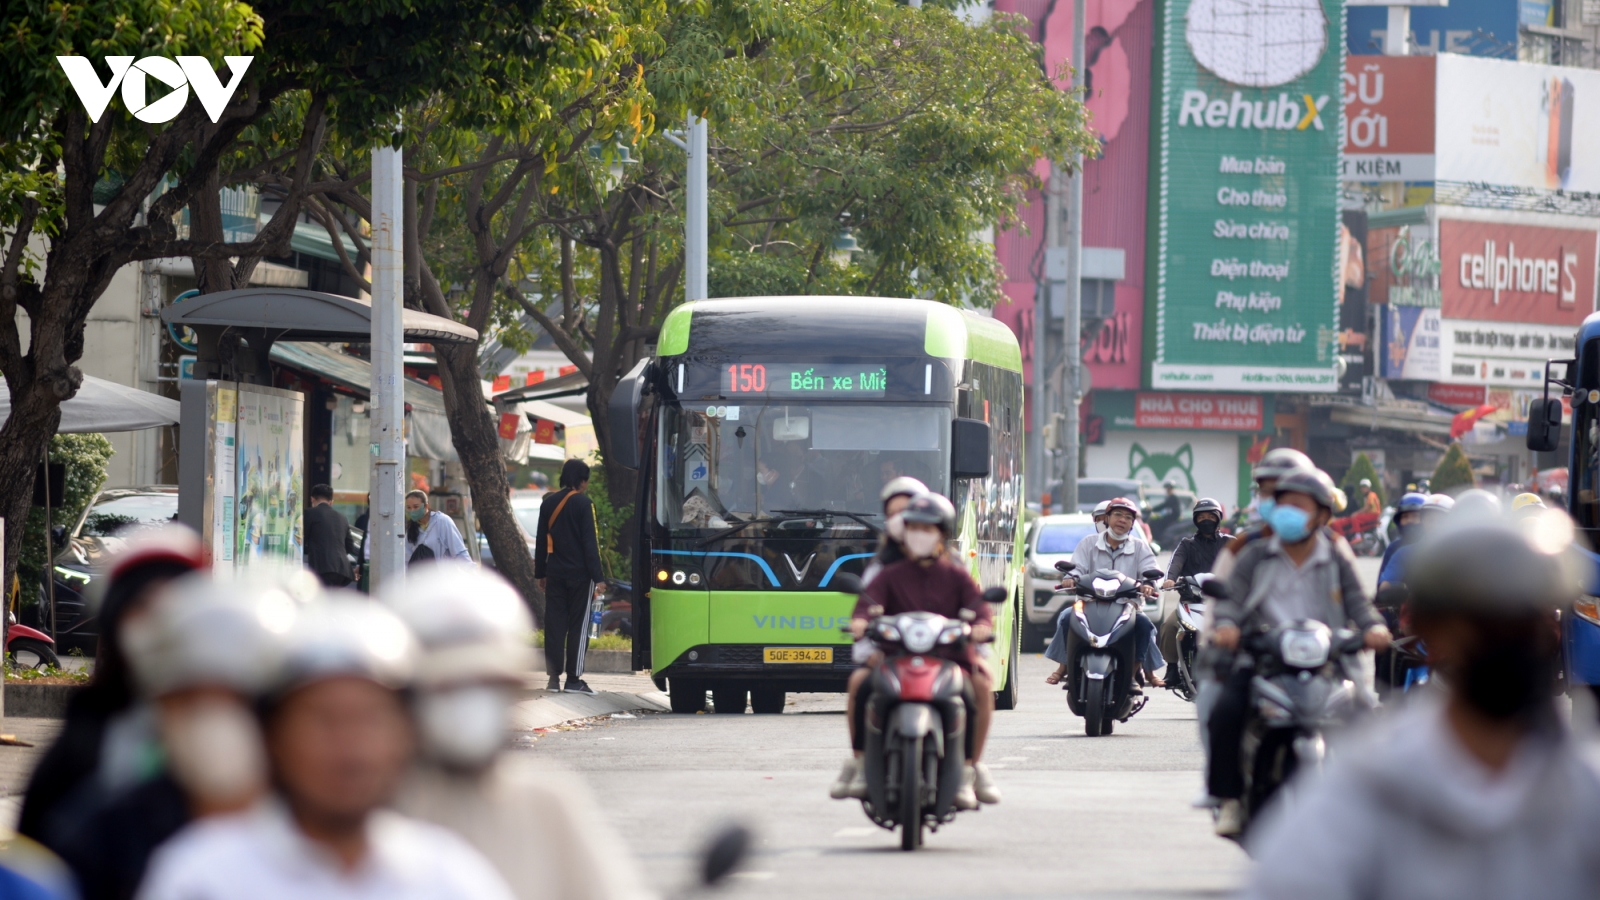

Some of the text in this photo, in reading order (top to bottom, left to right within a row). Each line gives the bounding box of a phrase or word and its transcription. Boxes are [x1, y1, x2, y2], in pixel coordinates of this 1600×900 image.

[1219, 156, 1285, 175] Mua bán
[1356, 157, 1401, 177] KIỆM
[1217, 187, 1287, 207] Cho thuê
[1213, 219, 1289, 239] Sửa chữa
[1210, 258, 1290, 282] Điện thoại
[1215, 291, 1281, 313] Phụ kiện
[1193, 318, 1306, 345] Thiết bị điện tử
[728, 364, 766, 392] 150
[833, 376, 853, 389] xe
[1140, 396, 1258, 415] NHÀ CHO THUÊ
[769, 651, 827, 661] 50E-394.28
